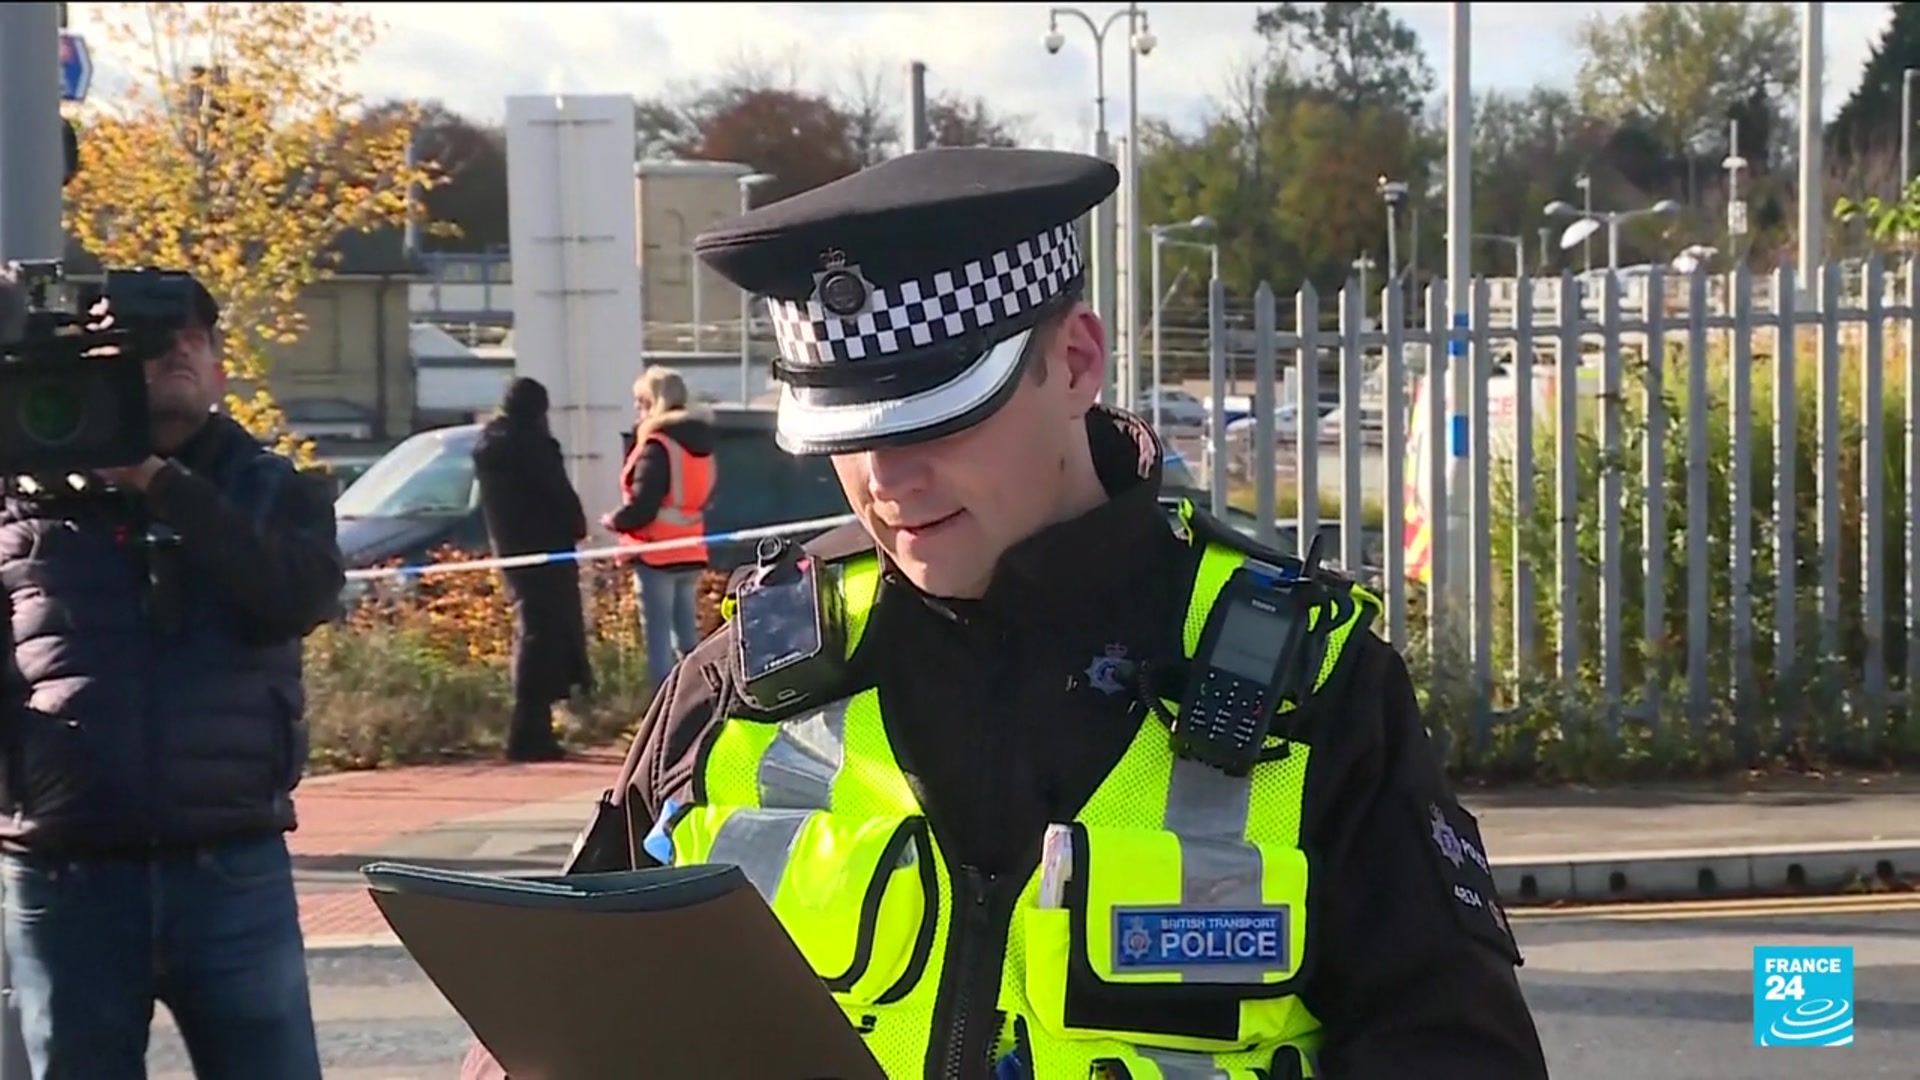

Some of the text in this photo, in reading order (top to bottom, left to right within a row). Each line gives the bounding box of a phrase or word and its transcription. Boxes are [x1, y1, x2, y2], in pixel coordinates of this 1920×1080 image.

[1161, 918, 1276, 930] BRITISH TRANSPORT
[1161, 931, 1277, 958] POLICE
